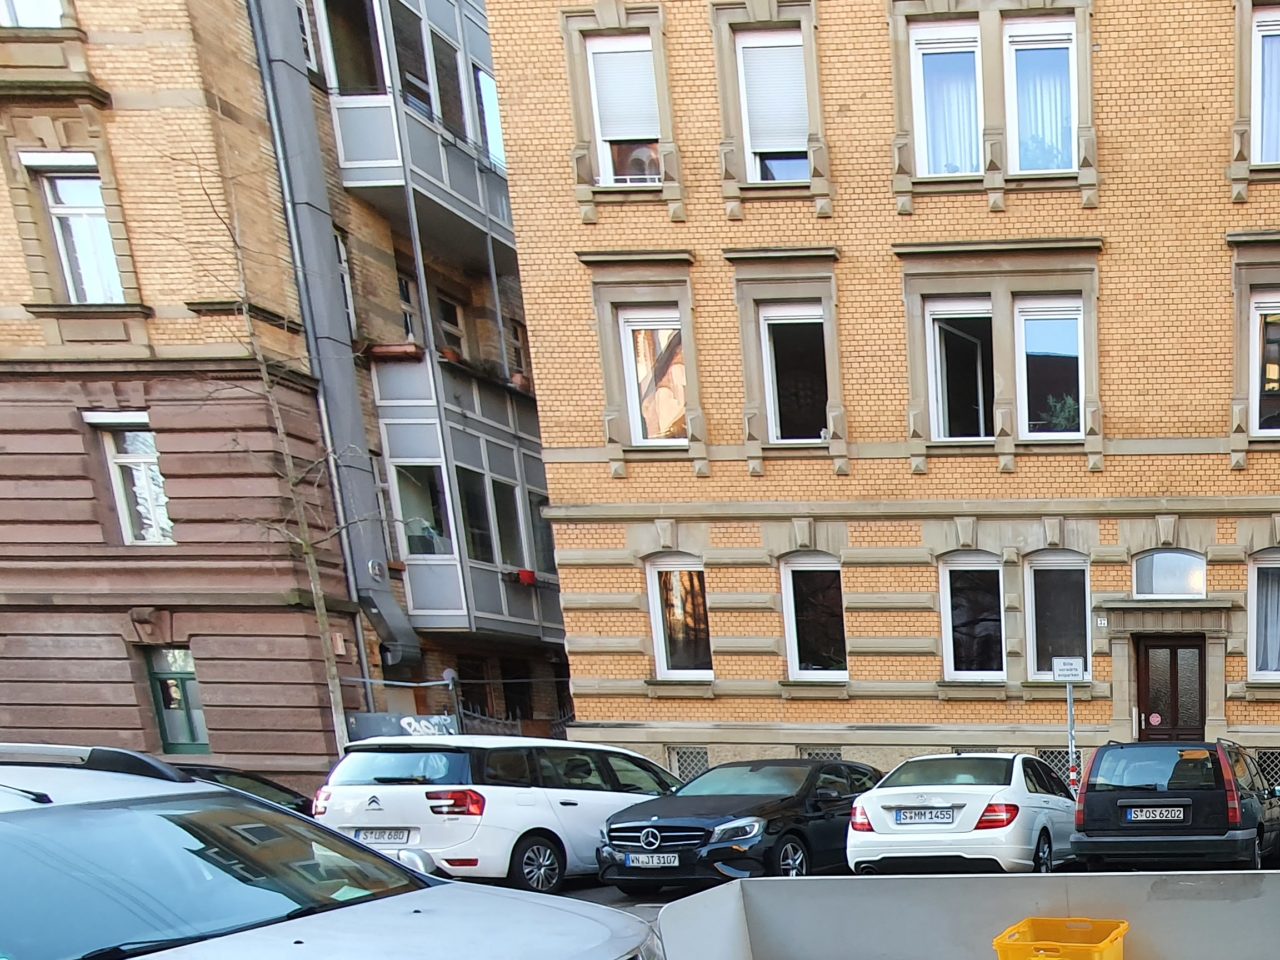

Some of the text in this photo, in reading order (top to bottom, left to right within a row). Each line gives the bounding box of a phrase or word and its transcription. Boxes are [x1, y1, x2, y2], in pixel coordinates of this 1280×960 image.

[928, 810, 952, 820] 1455
[1158, 809, 1182, 819] 6202
[387, 831, 405, 840] 680
[656, 855, 678, 865] 3107
